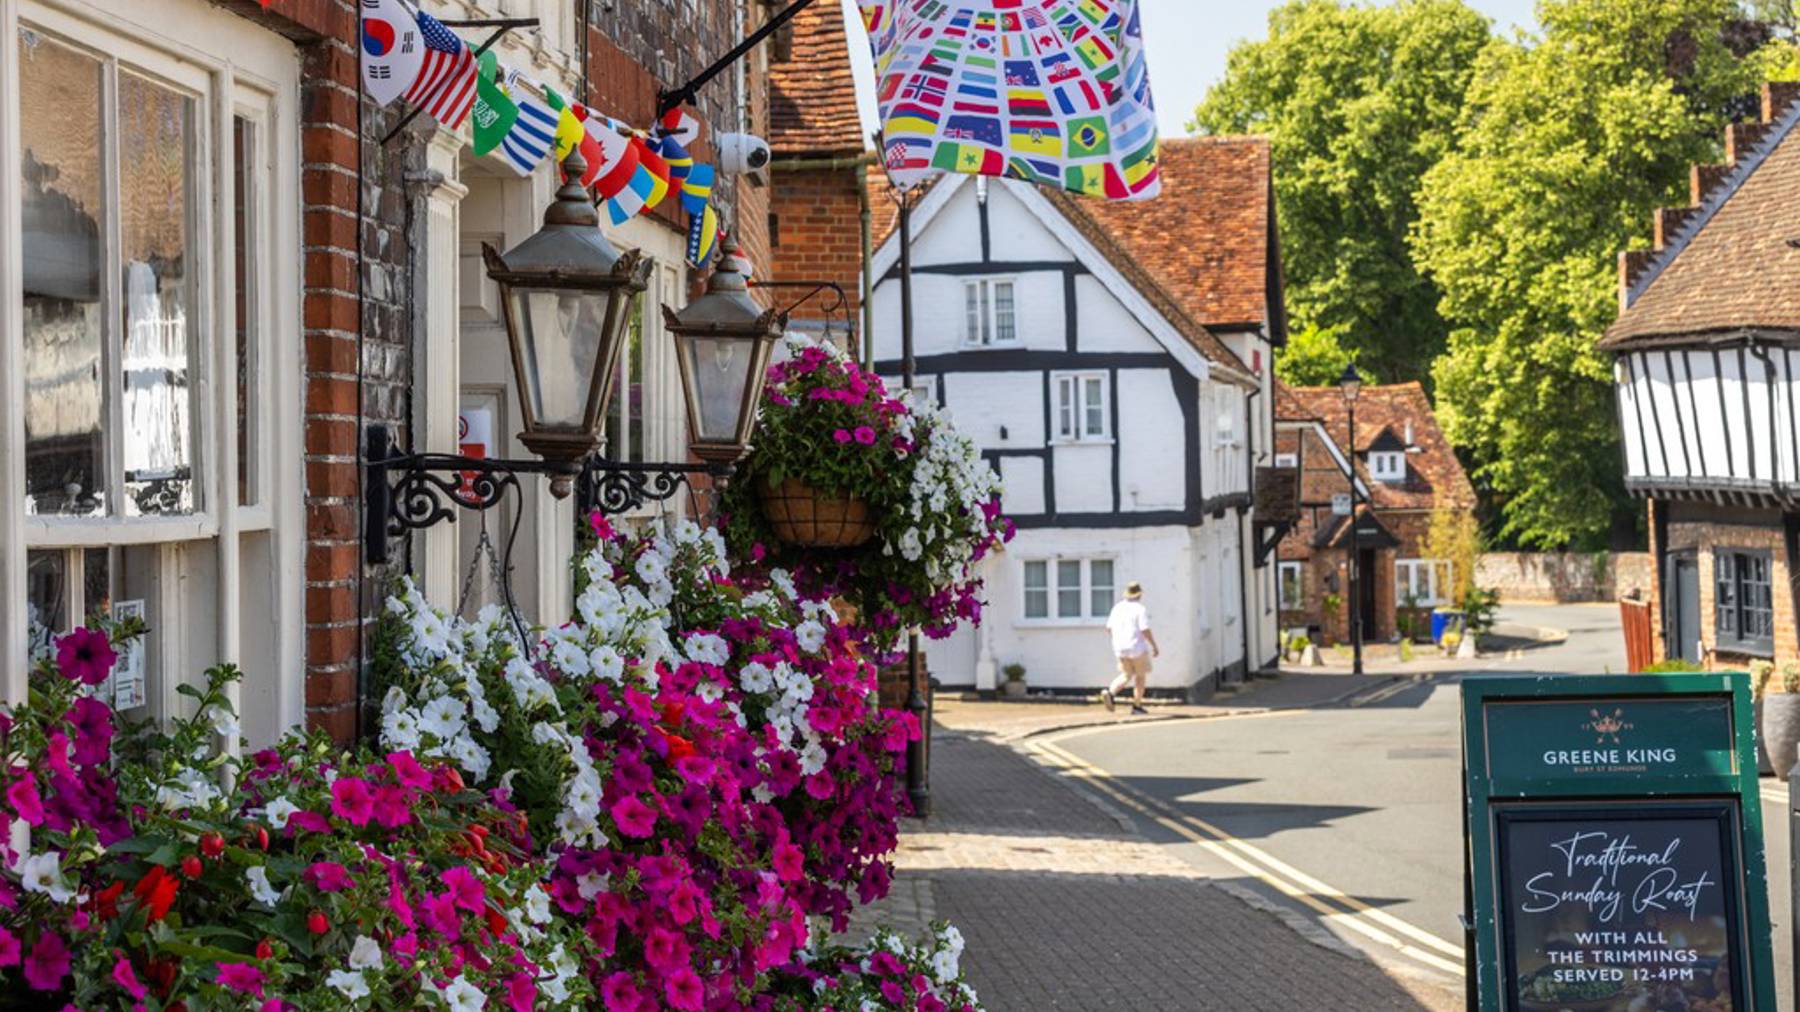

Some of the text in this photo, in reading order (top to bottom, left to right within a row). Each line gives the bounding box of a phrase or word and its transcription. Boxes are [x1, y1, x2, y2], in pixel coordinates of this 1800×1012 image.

[1543, 748, 1677, 765] GREENE KING
[1550, 831, 1681, 887] Traditional
[1521, 867, 1715, 923] Sunday Roast
[1574, 931, 1668, 945] WITH ALL
[1547, 950, 1698, 964] THE TRIMMINGS
[1553, 967, 1694, 982] SERVED 12-4PM
